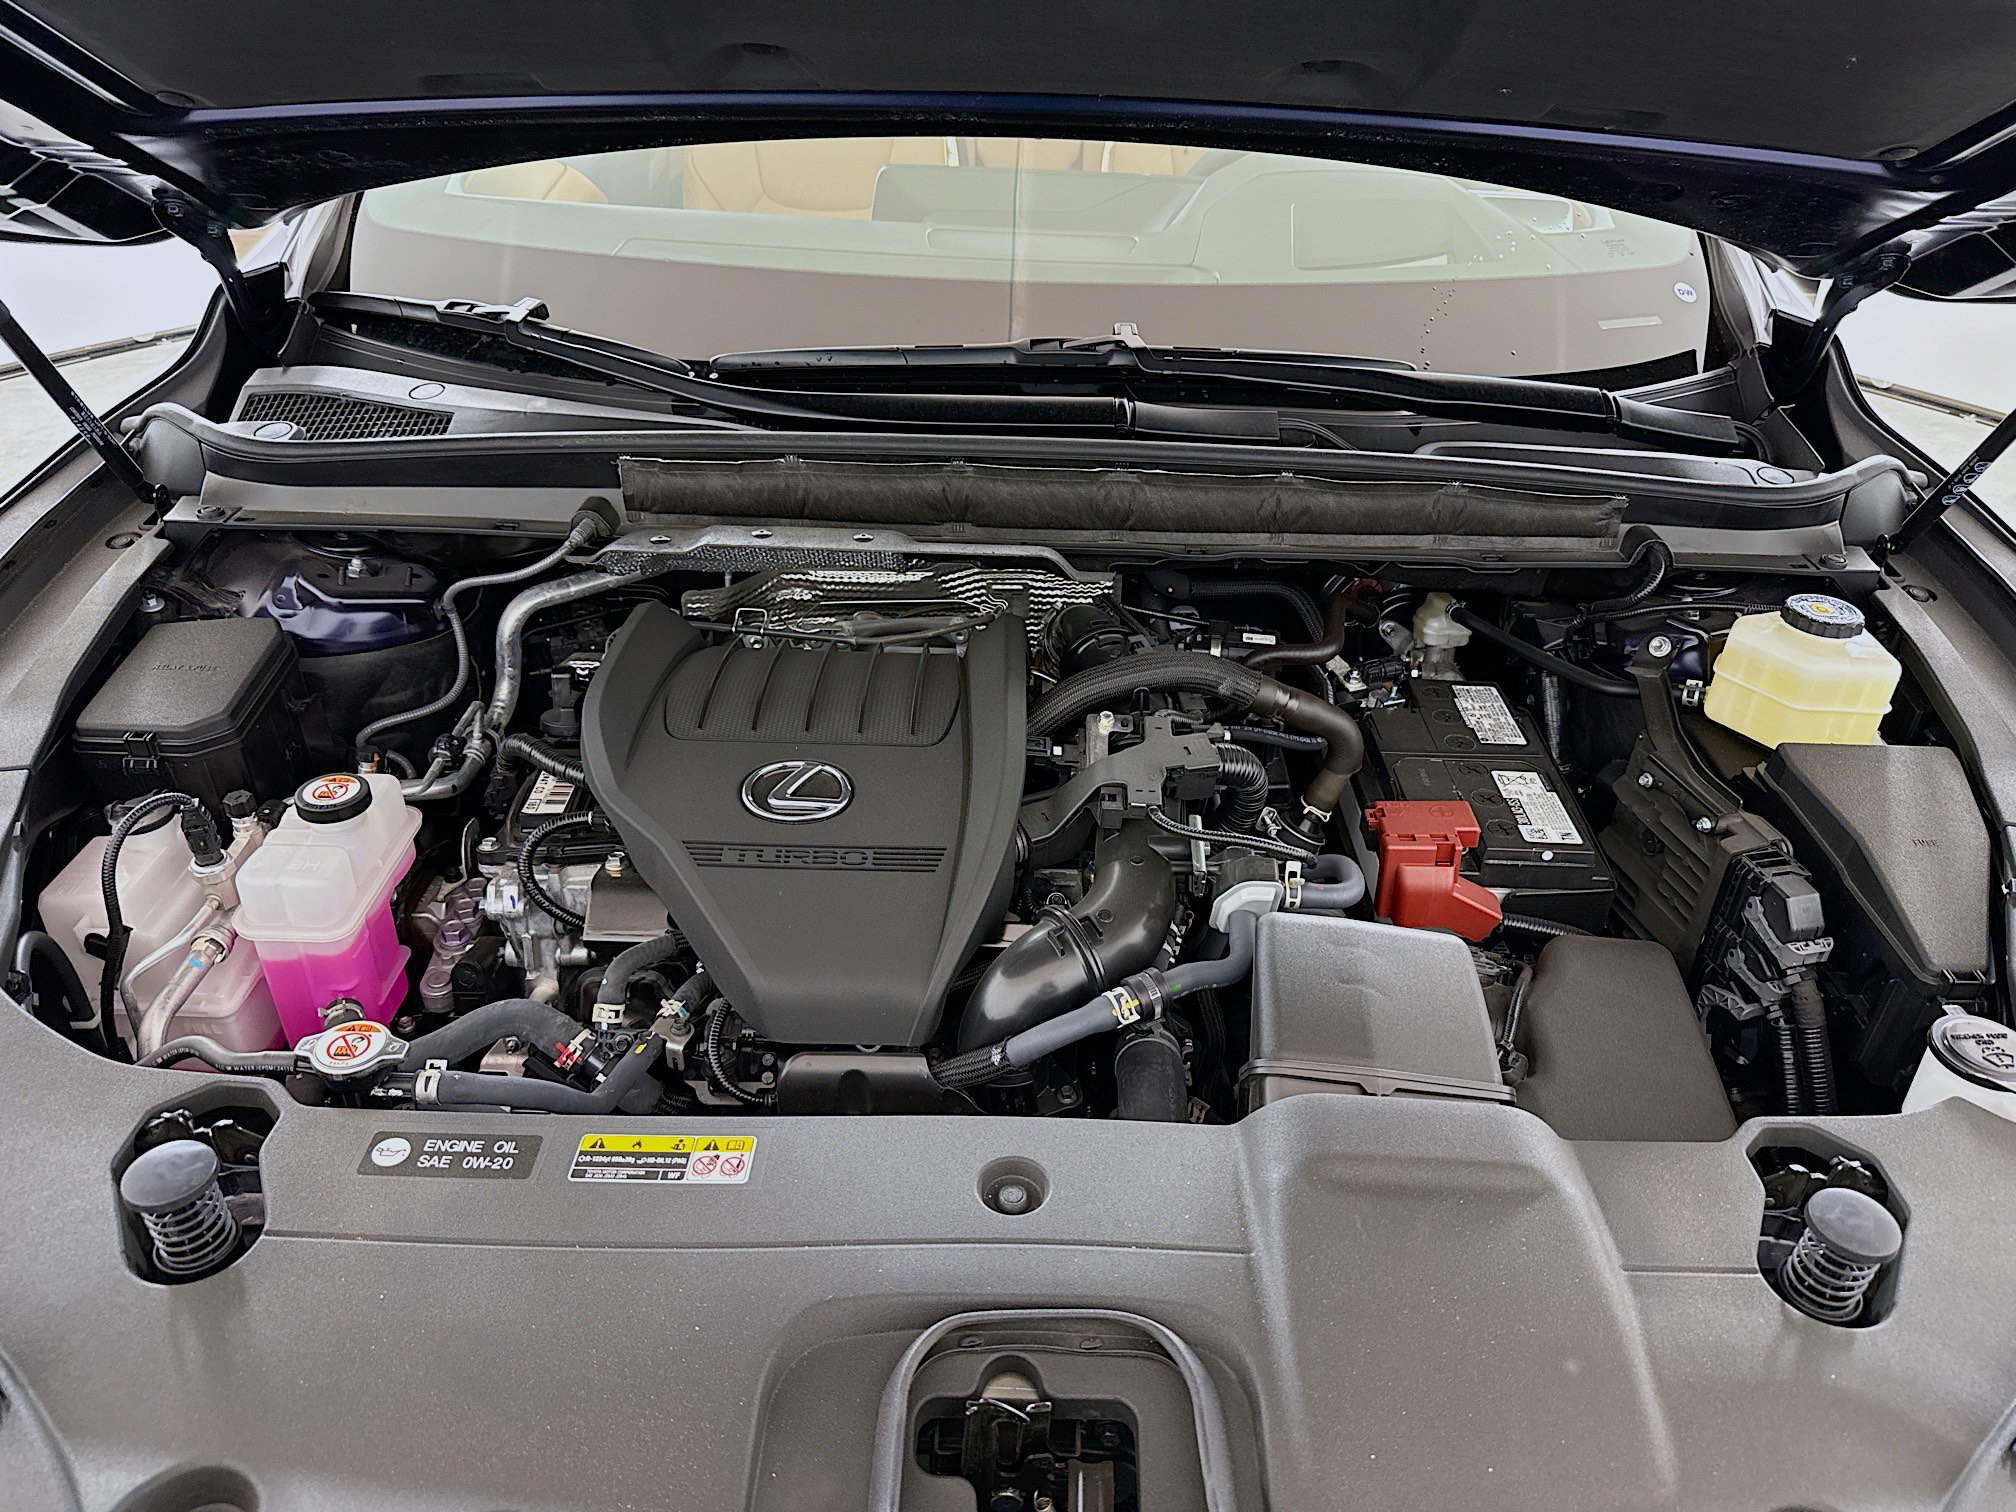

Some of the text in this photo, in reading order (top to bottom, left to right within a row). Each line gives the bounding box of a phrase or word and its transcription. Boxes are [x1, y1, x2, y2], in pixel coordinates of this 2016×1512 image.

[727, 848, 868, 866] TURBO
[423, 1139, 519, 1154] ENGINE OIL
[417, 1155, 514, 1170] SAE 0W-20
